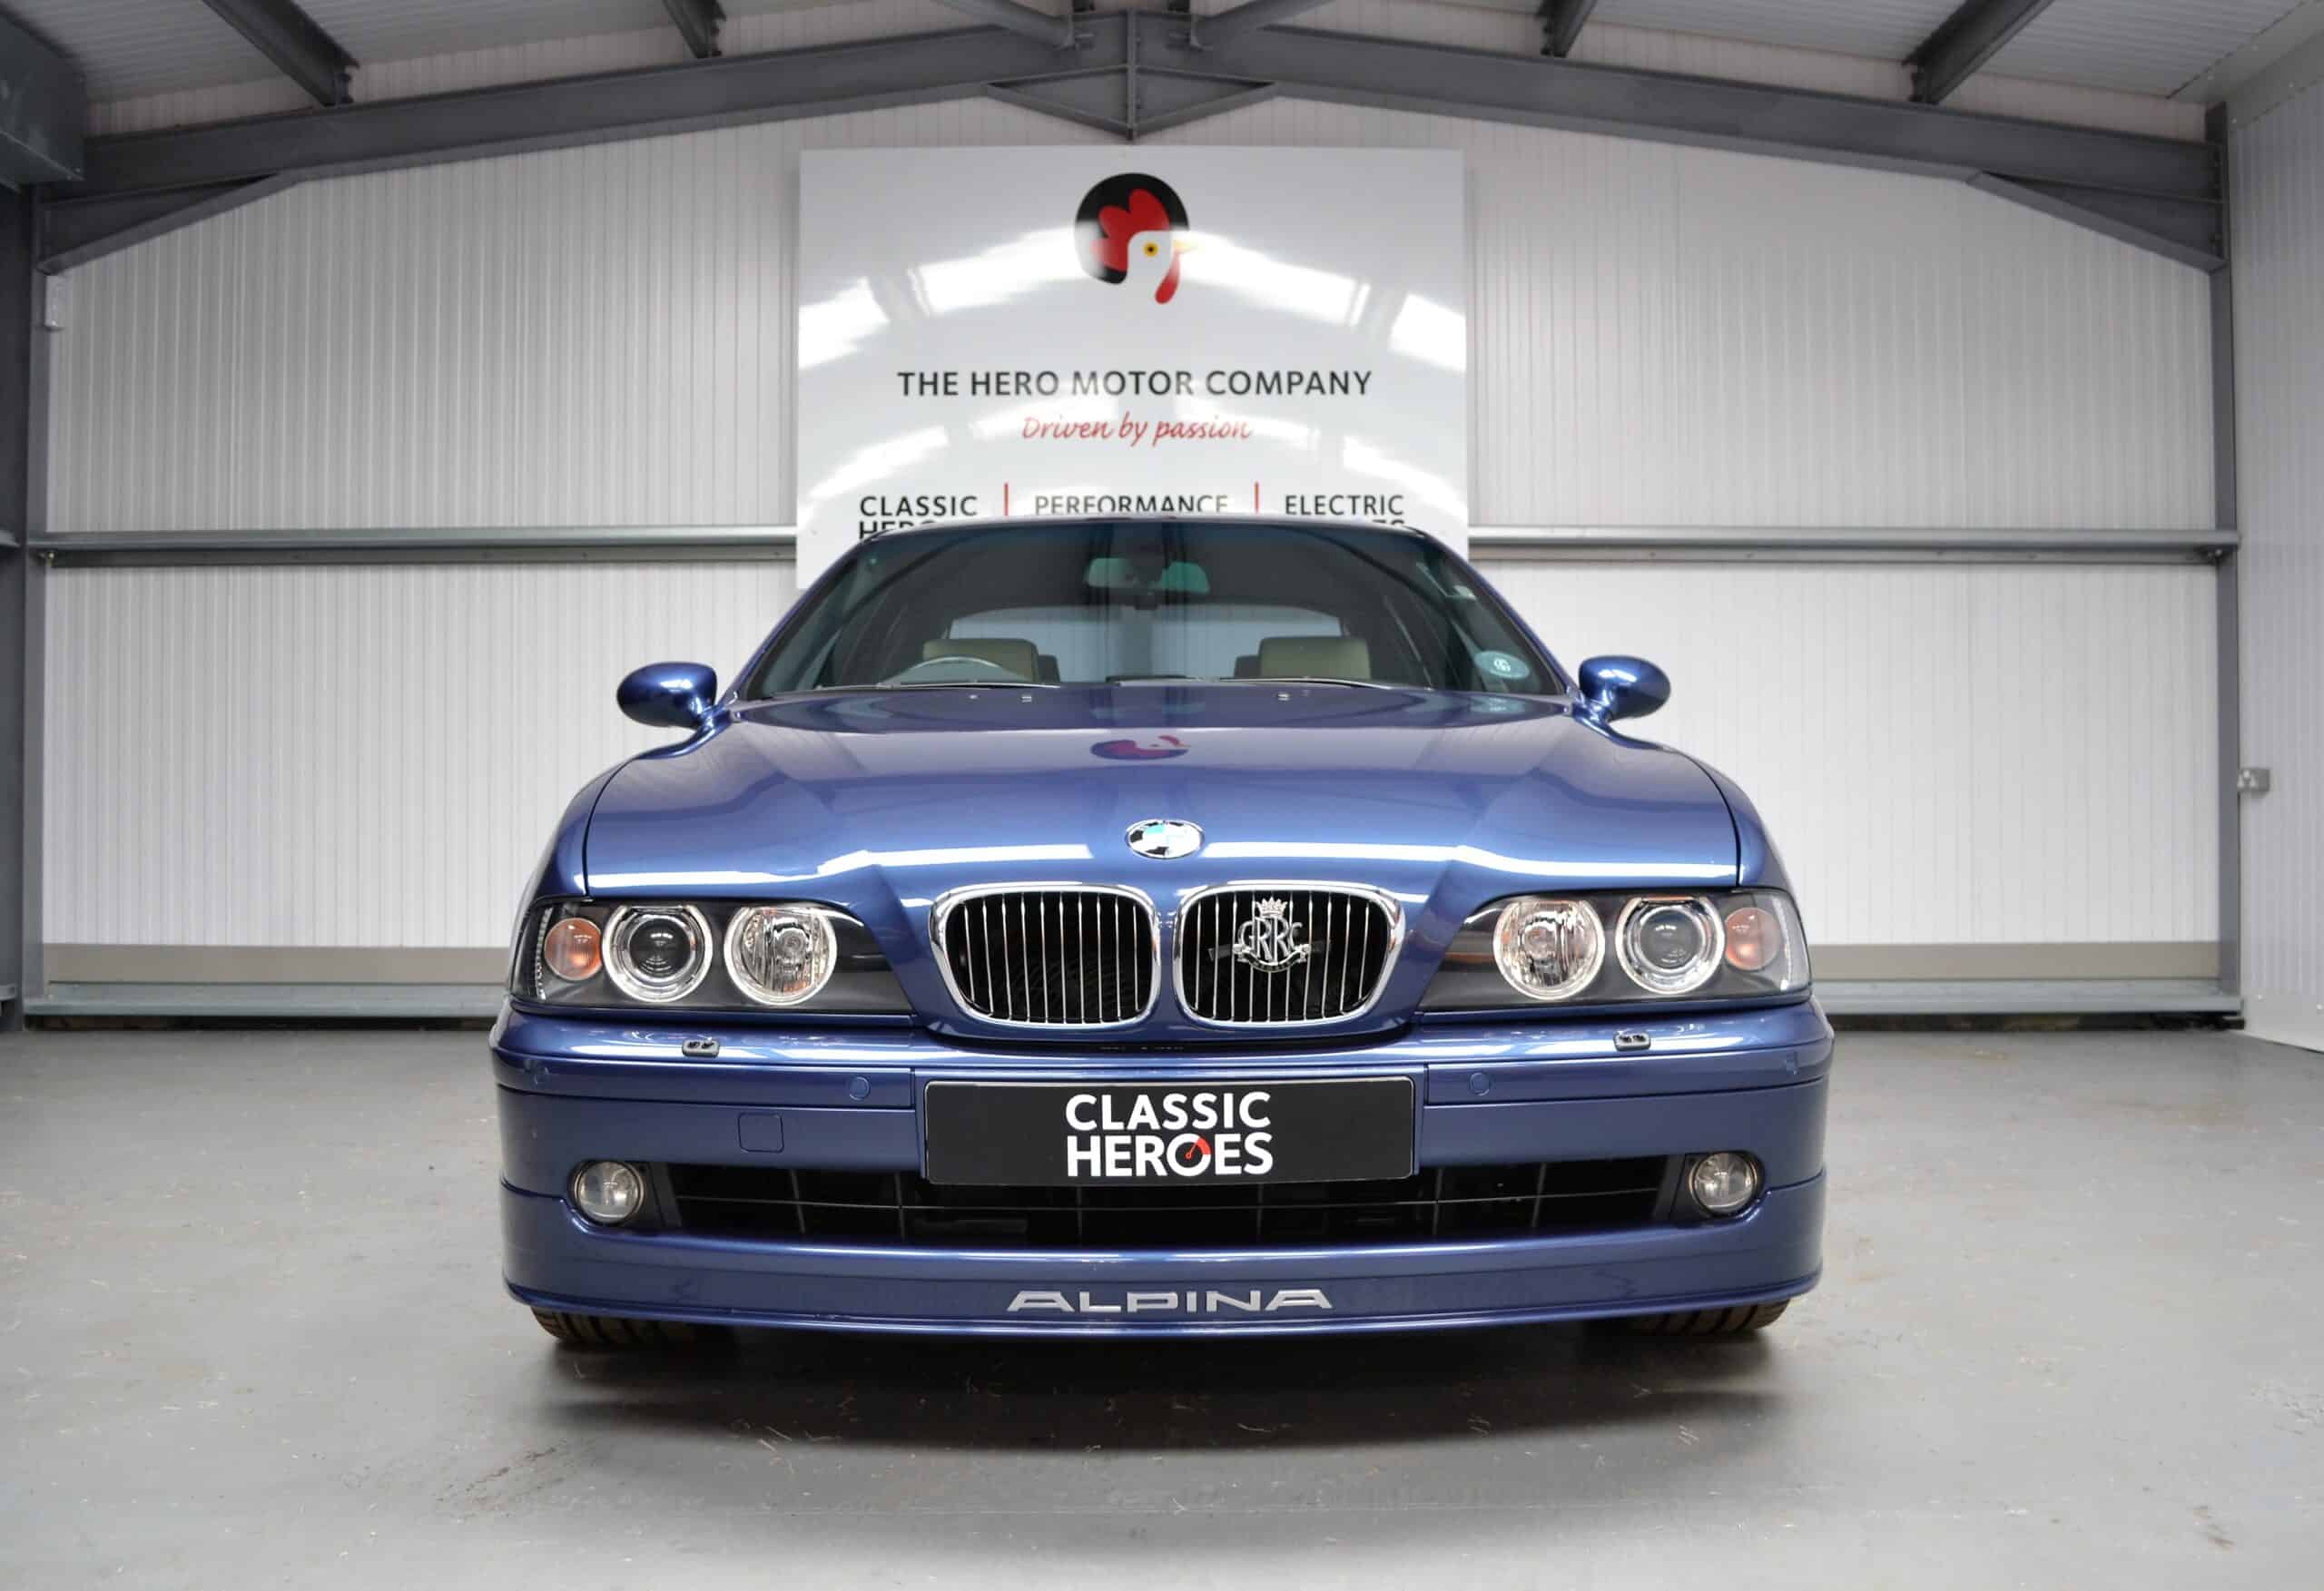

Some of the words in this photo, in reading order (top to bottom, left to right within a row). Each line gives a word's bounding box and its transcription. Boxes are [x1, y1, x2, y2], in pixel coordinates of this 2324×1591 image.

[897, 371, 960, 397] THE
[970, 370, 1060, 397] HERO
[1071, 370, 1195, 397] MOTOR
[1206, 369, 1373, 397] COMPANY
[1021, 415, 1115, 440] Driven
[1118, 410, 1149, 448] by
[1151, 414, 1253, 448] passion
[859, 495, 979, 517] CLASSIC
[1285, 495, 1405, 516] ELECTRIC
[1065, 1091, 1272, 1132] CLASSIC
[1066, 1132, 1274, 1178] HEROES
[1006, 1289, 1334, 1314] ALPINA
